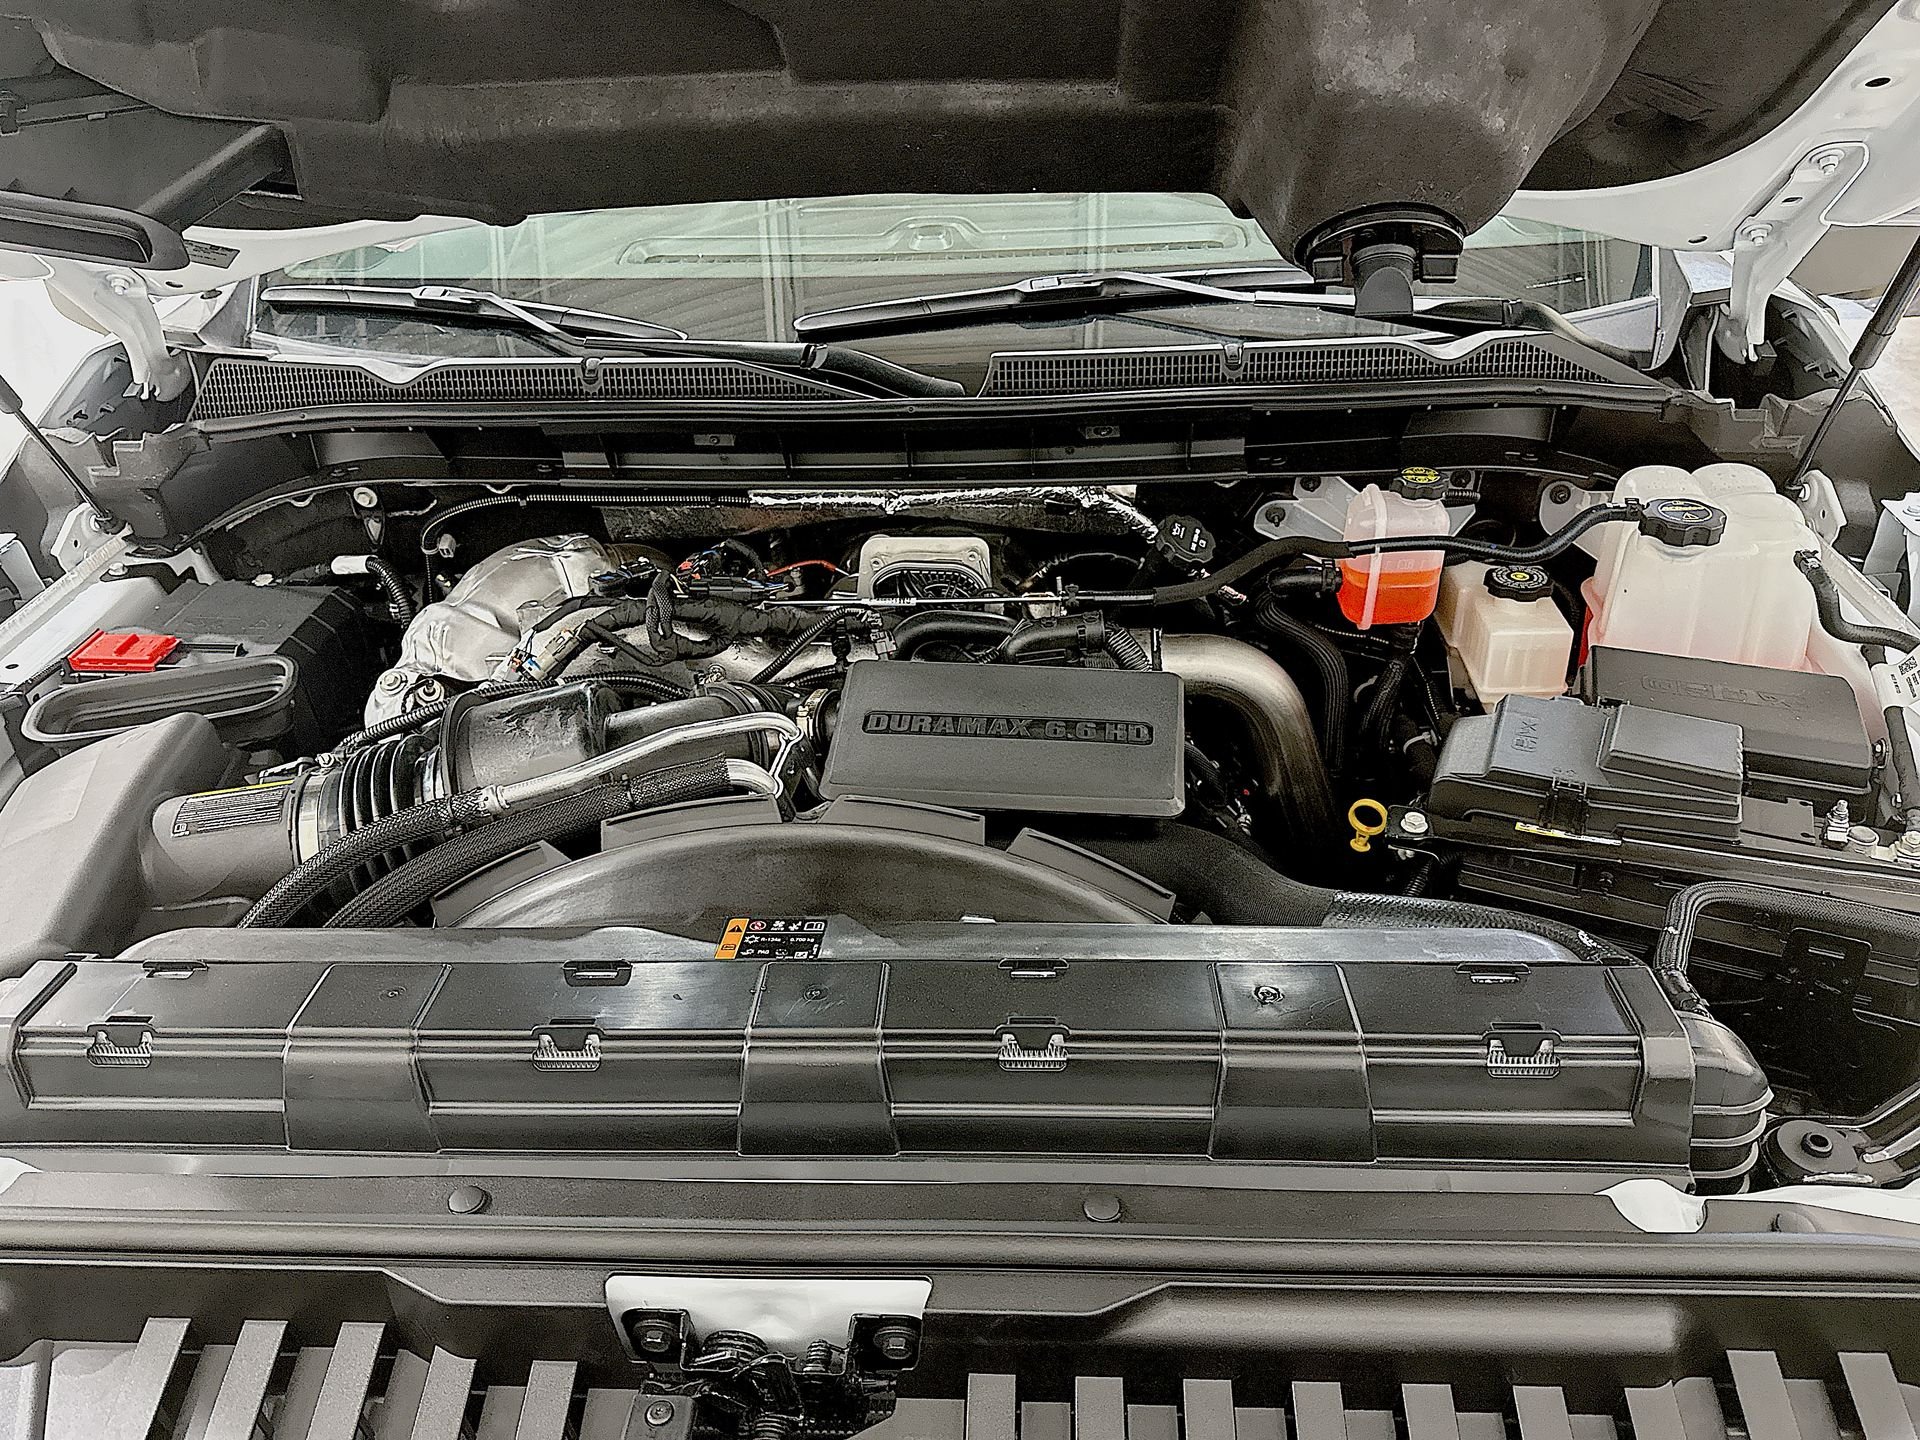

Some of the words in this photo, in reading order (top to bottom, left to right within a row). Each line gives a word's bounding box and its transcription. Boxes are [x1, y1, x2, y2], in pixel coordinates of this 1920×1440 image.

[866, 714, 1033, 737] DURAMAX
[1044, 720, 1097, 740] 6.6
[1104, 722, 1152, 743] HD
